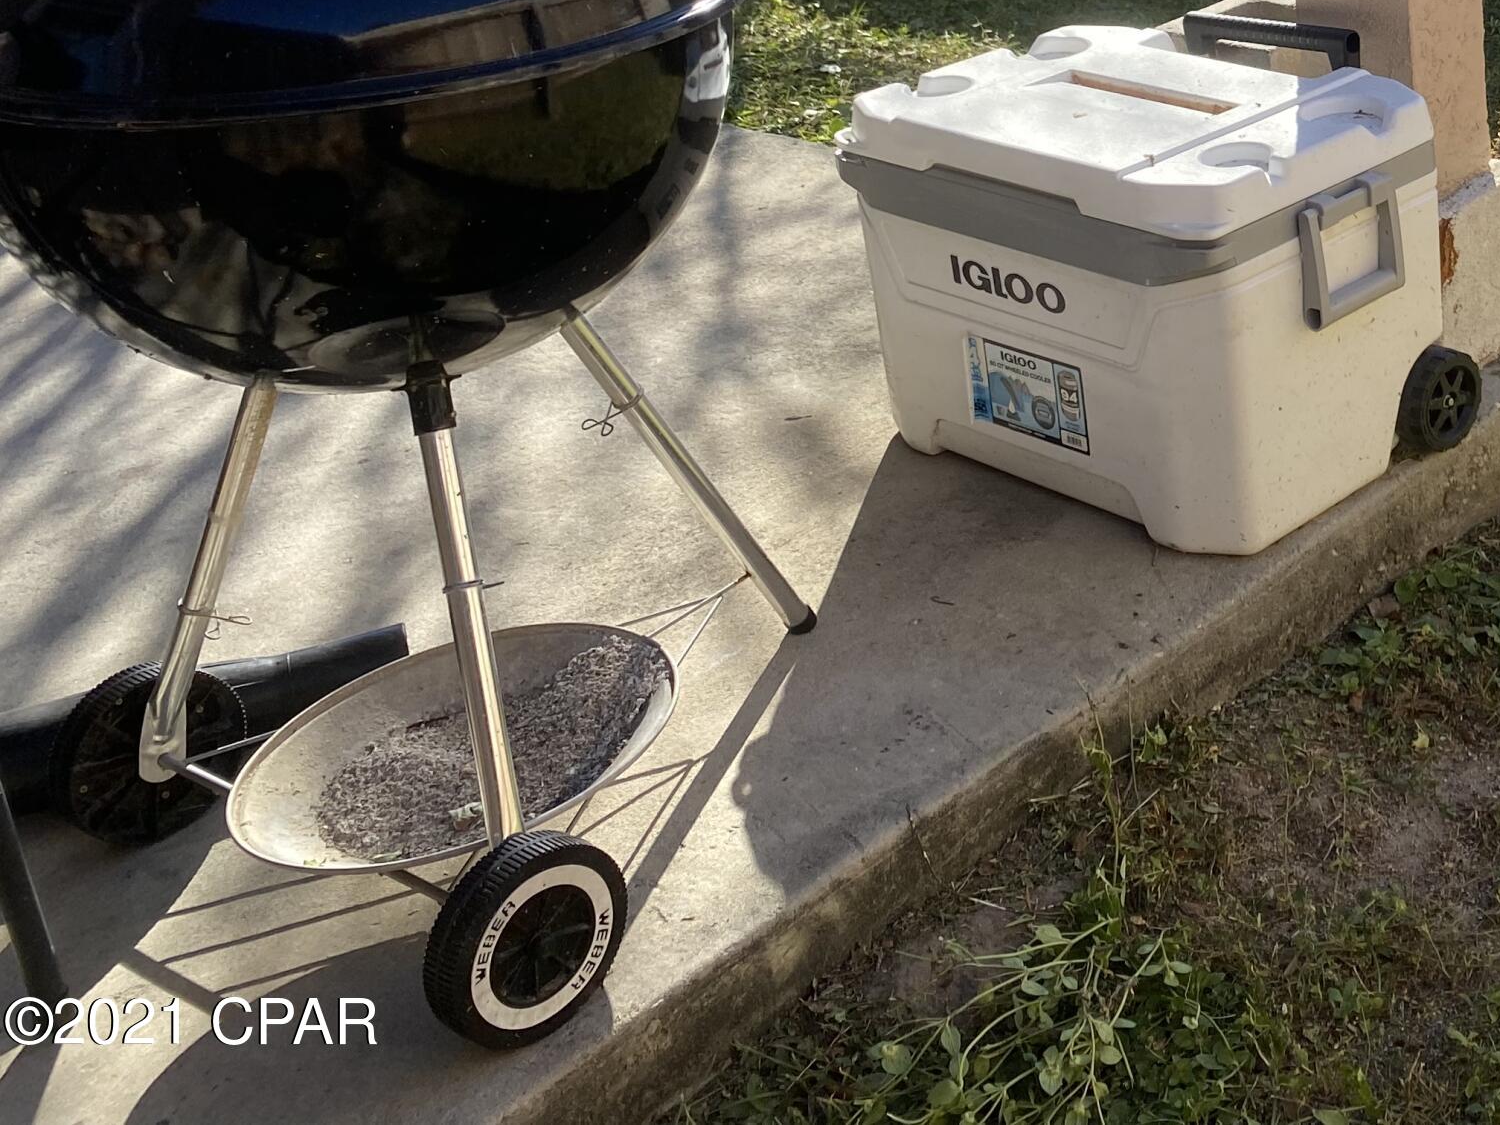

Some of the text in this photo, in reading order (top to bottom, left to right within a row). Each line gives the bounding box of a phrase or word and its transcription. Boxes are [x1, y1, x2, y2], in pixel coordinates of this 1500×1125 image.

[950, 254, 1066, 314] IGLOO
[1000, 350, 1037, 370] IGLOO
[1030, 372, 1052, 384] COOLER
[1060, 388, 1078, 403] 94
[474, 900, 516, 985] WEBER
[571, 908, 610, 991] WEBER
